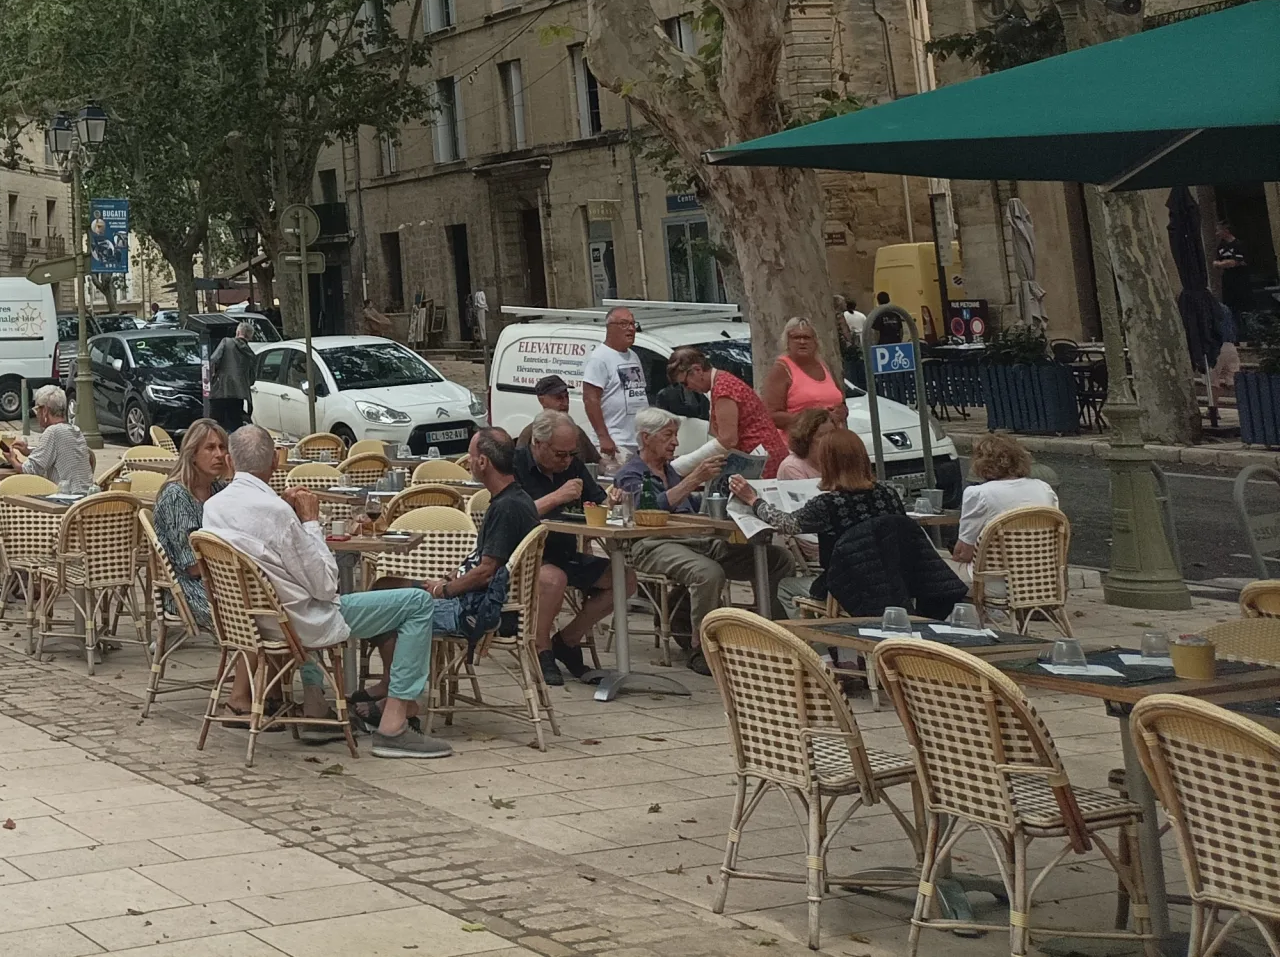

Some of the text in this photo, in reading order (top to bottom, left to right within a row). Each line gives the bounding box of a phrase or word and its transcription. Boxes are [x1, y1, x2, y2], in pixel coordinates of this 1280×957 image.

[102, 210, 127, 218] BUGATTI
[518, 341, 586, 356] ELEVATEURS
[875, 347, 890, 373] P
